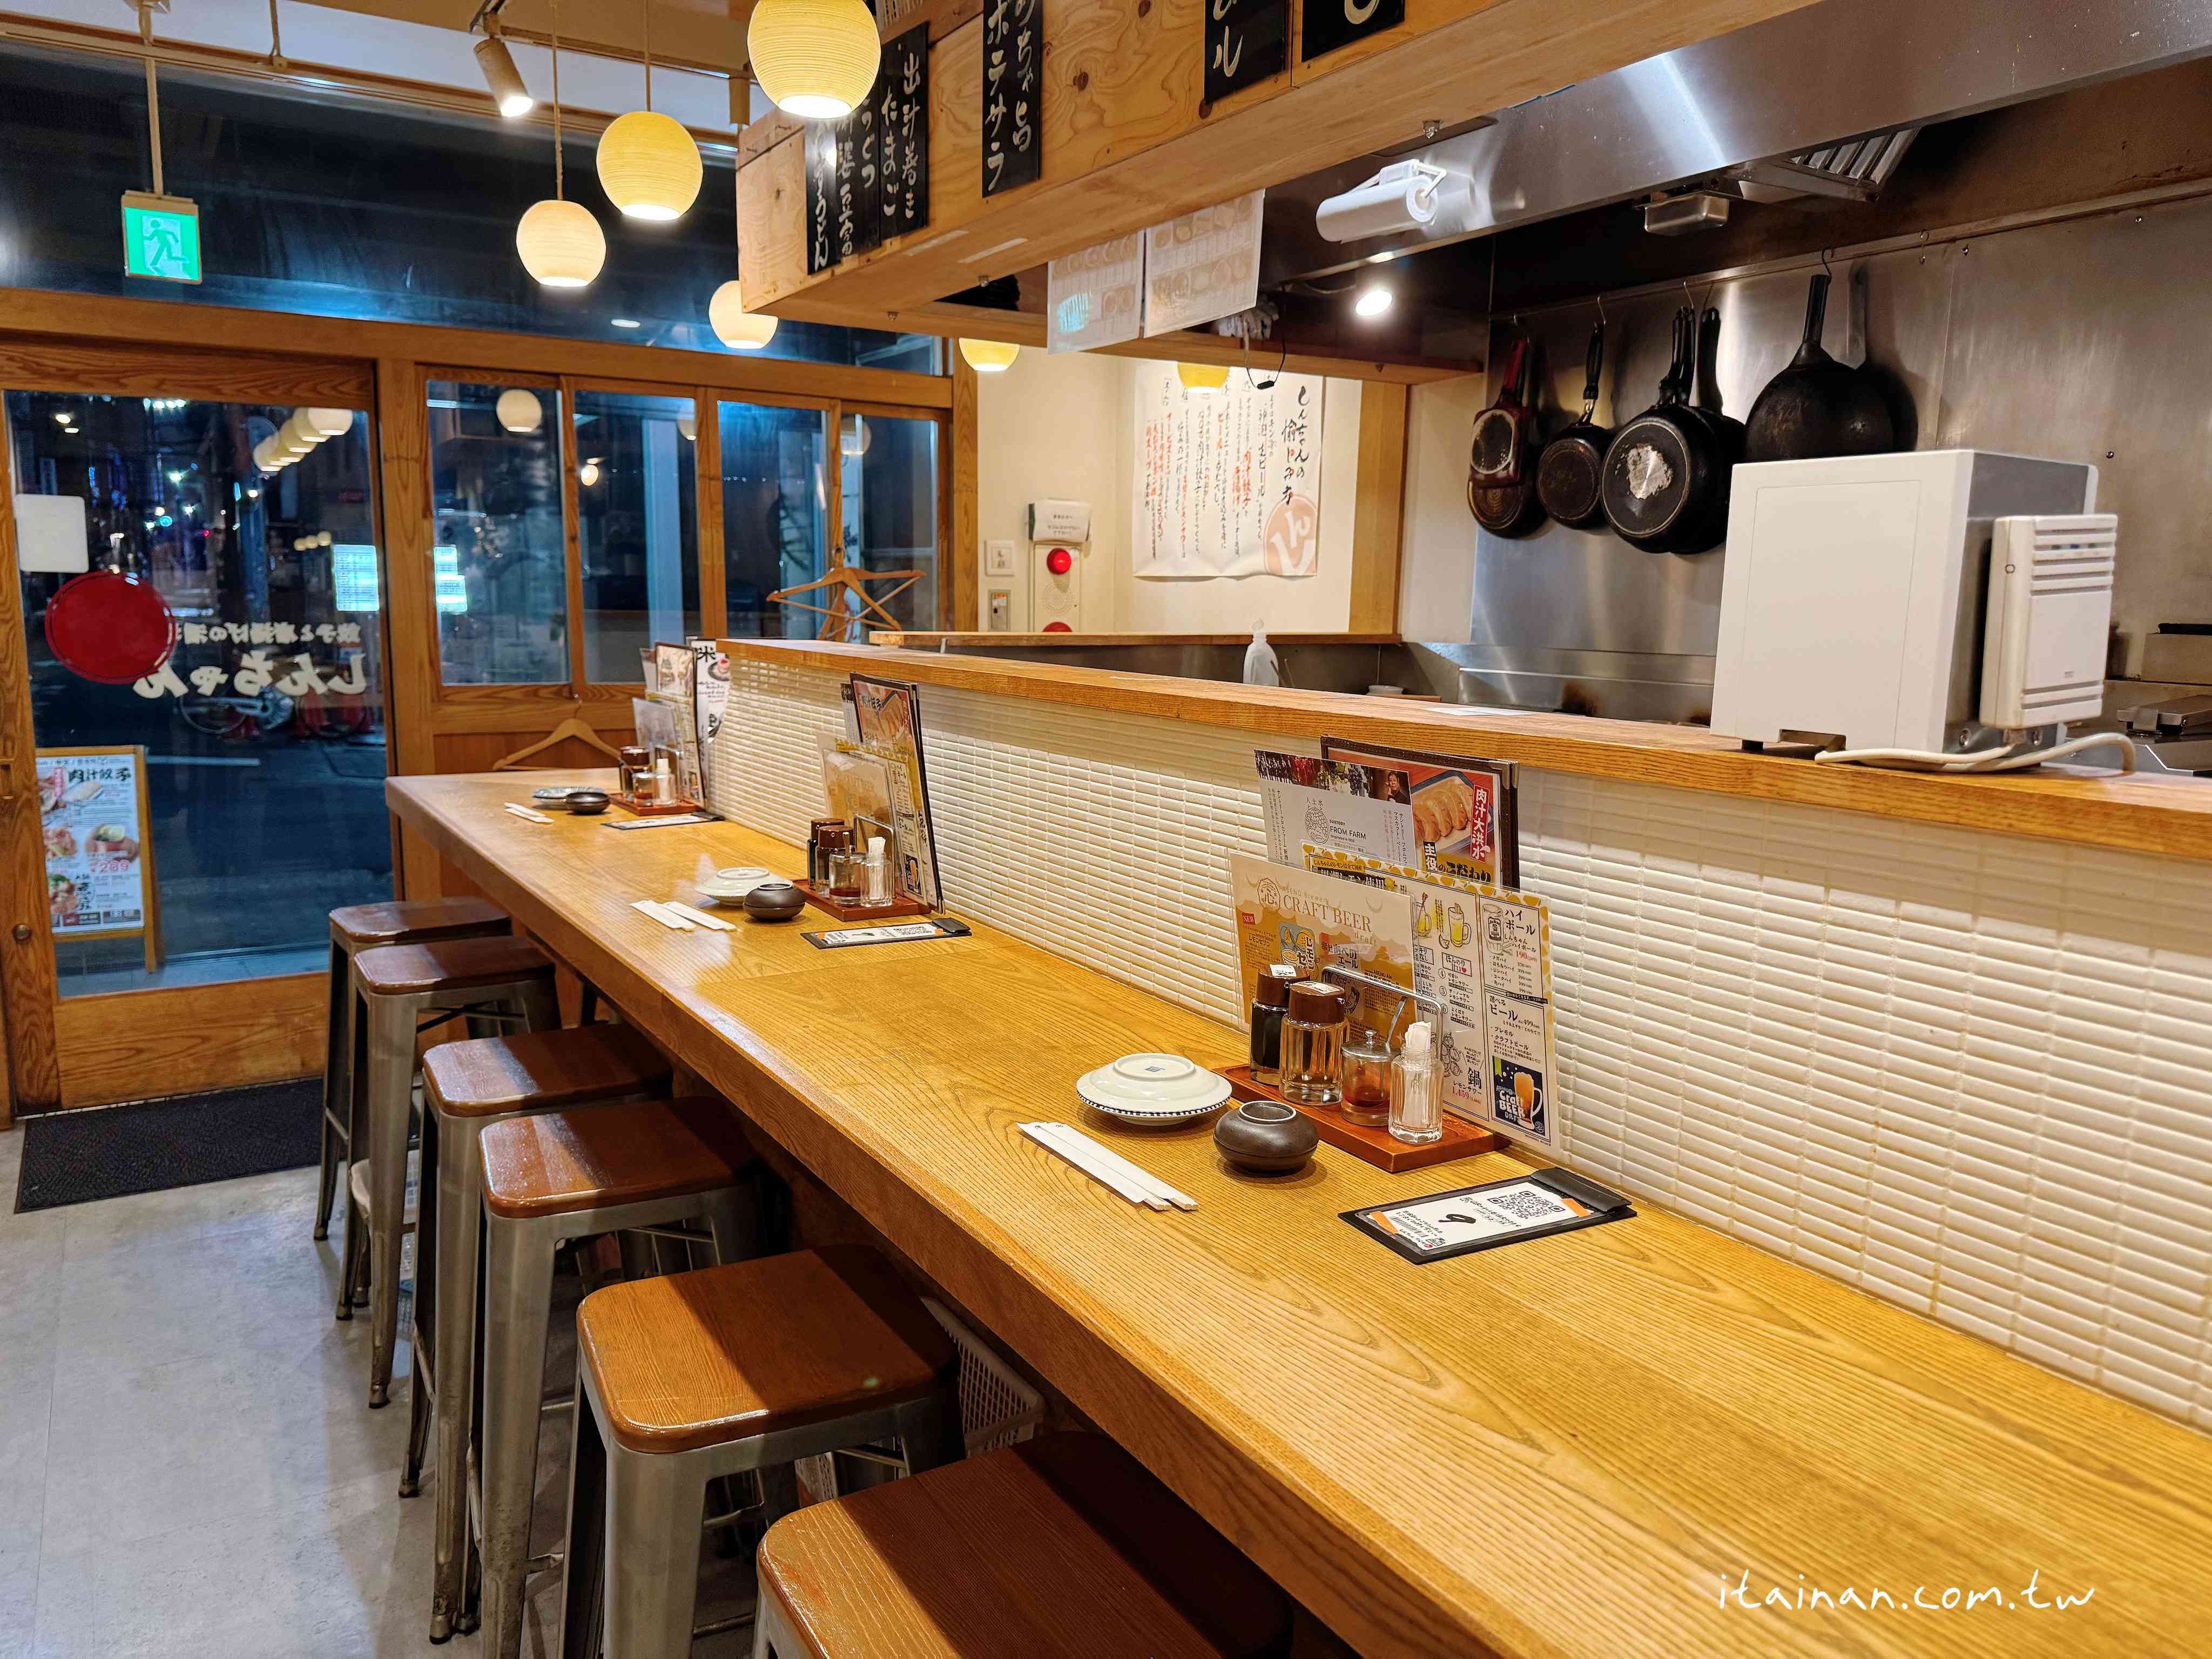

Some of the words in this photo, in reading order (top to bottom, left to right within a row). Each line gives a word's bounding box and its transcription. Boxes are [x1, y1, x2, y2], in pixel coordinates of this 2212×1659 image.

[861, 98, 875, 188] つぐつ
[902, 53, 920, 219] 出汁巻き
[881, 85, 899, 216] たまご
[697, 645, 716, 663] 米
[1330, 826, 1347, 835] FROM
[1349, 830, 1366, 840] FARM
[1472, 788, 1487, 860] 肉汁大洪水
[1424, 844, 1438, 871] 主役
[1243, 915, 1254, 923] NEW
[1284, 895, 1330, 920] CRAFT
[1331, 907, 1372, 933] BEER
[1505, 909, 1522, 921] ハイ
[1506, 919, 1536, 936] ボール
[1490, 1003, 1518, 1021] ビール
[1495, 1035, 1529, 1051] クラフトビール
[1468, 1067, 1482, 1089] 鍋
[1453, 1080, 1482, 1095] レモンサワー
